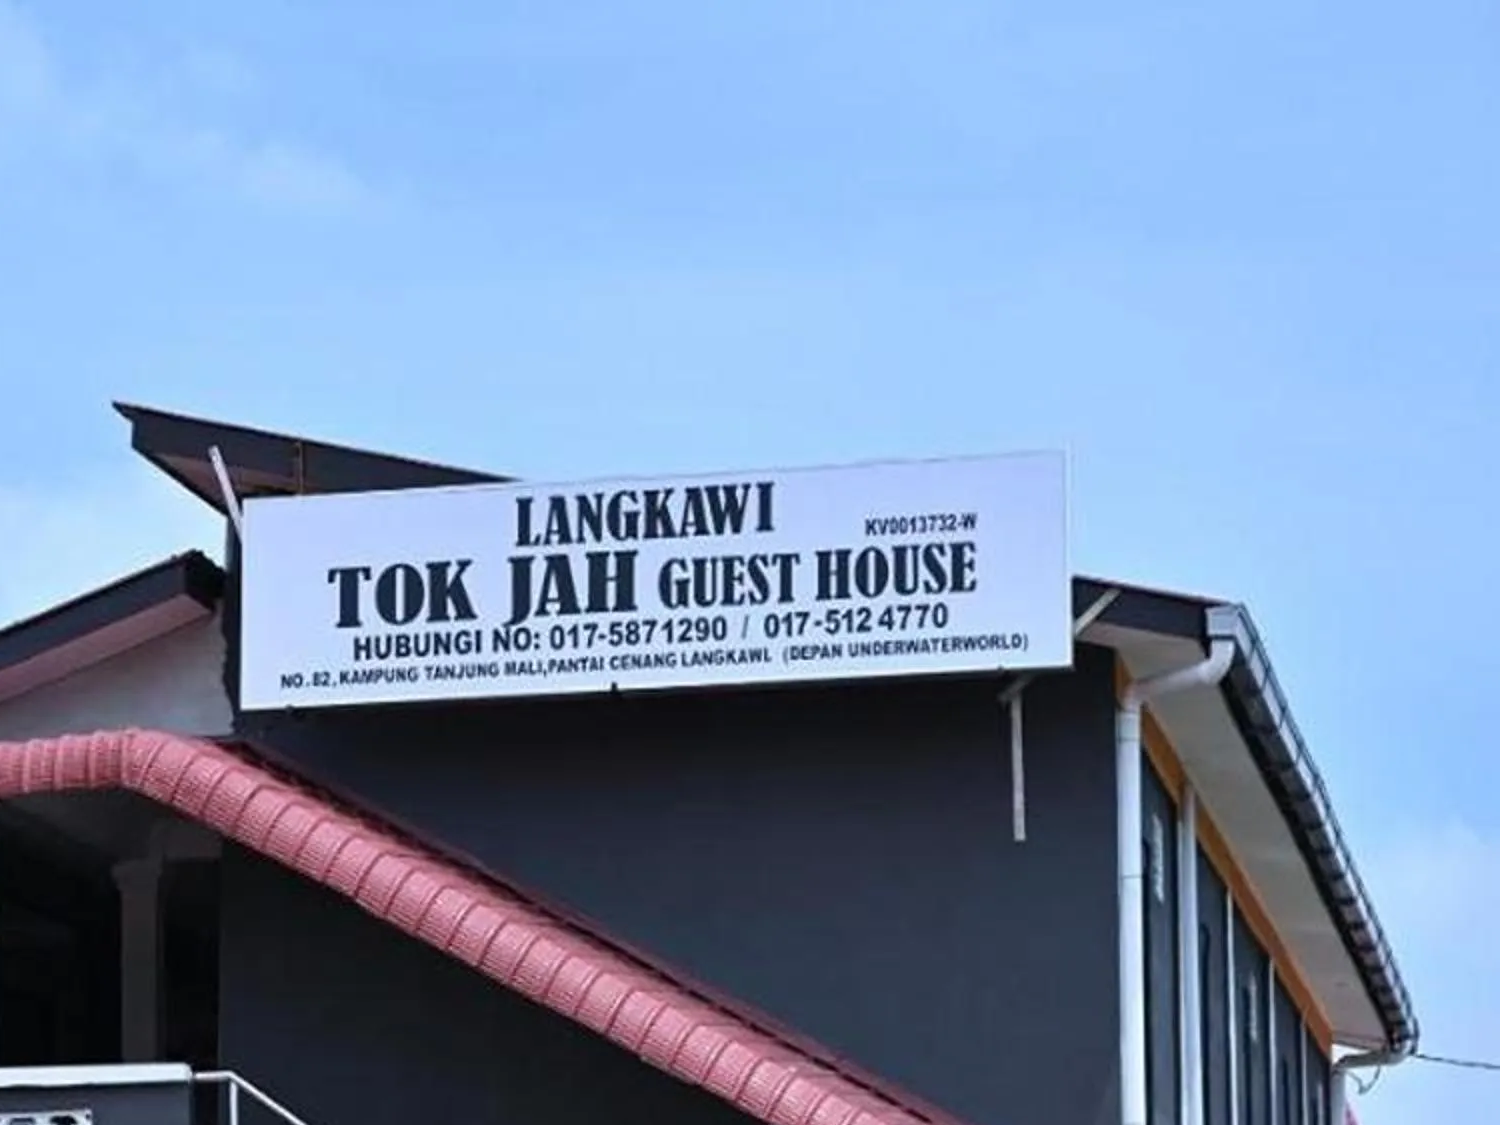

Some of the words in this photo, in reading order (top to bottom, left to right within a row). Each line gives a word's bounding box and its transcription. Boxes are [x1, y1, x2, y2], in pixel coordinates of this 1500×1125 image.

[516, 481, 775, 547] LANGKAWI
[327, 559, 478, 628] TOK
[502, 551, 638, 626] JAH
[658, 552, 800, 609] GUEST
[815, 541, 977, 600] HOUSE
[353, 629, 482, 661] HUBUNGI
[493, 626, 541, 653] NO:
[550, 614, 727, 650] 017-5871290
[740, 613, 750, 639] /
[424, 661, 500, 680] TANJUNG
[609, 651, 677, 671] CENANG
[782, 642, 843, 664] (DEPAN
[848, 632, 1029, 658] UNDERWATERWORLD)
